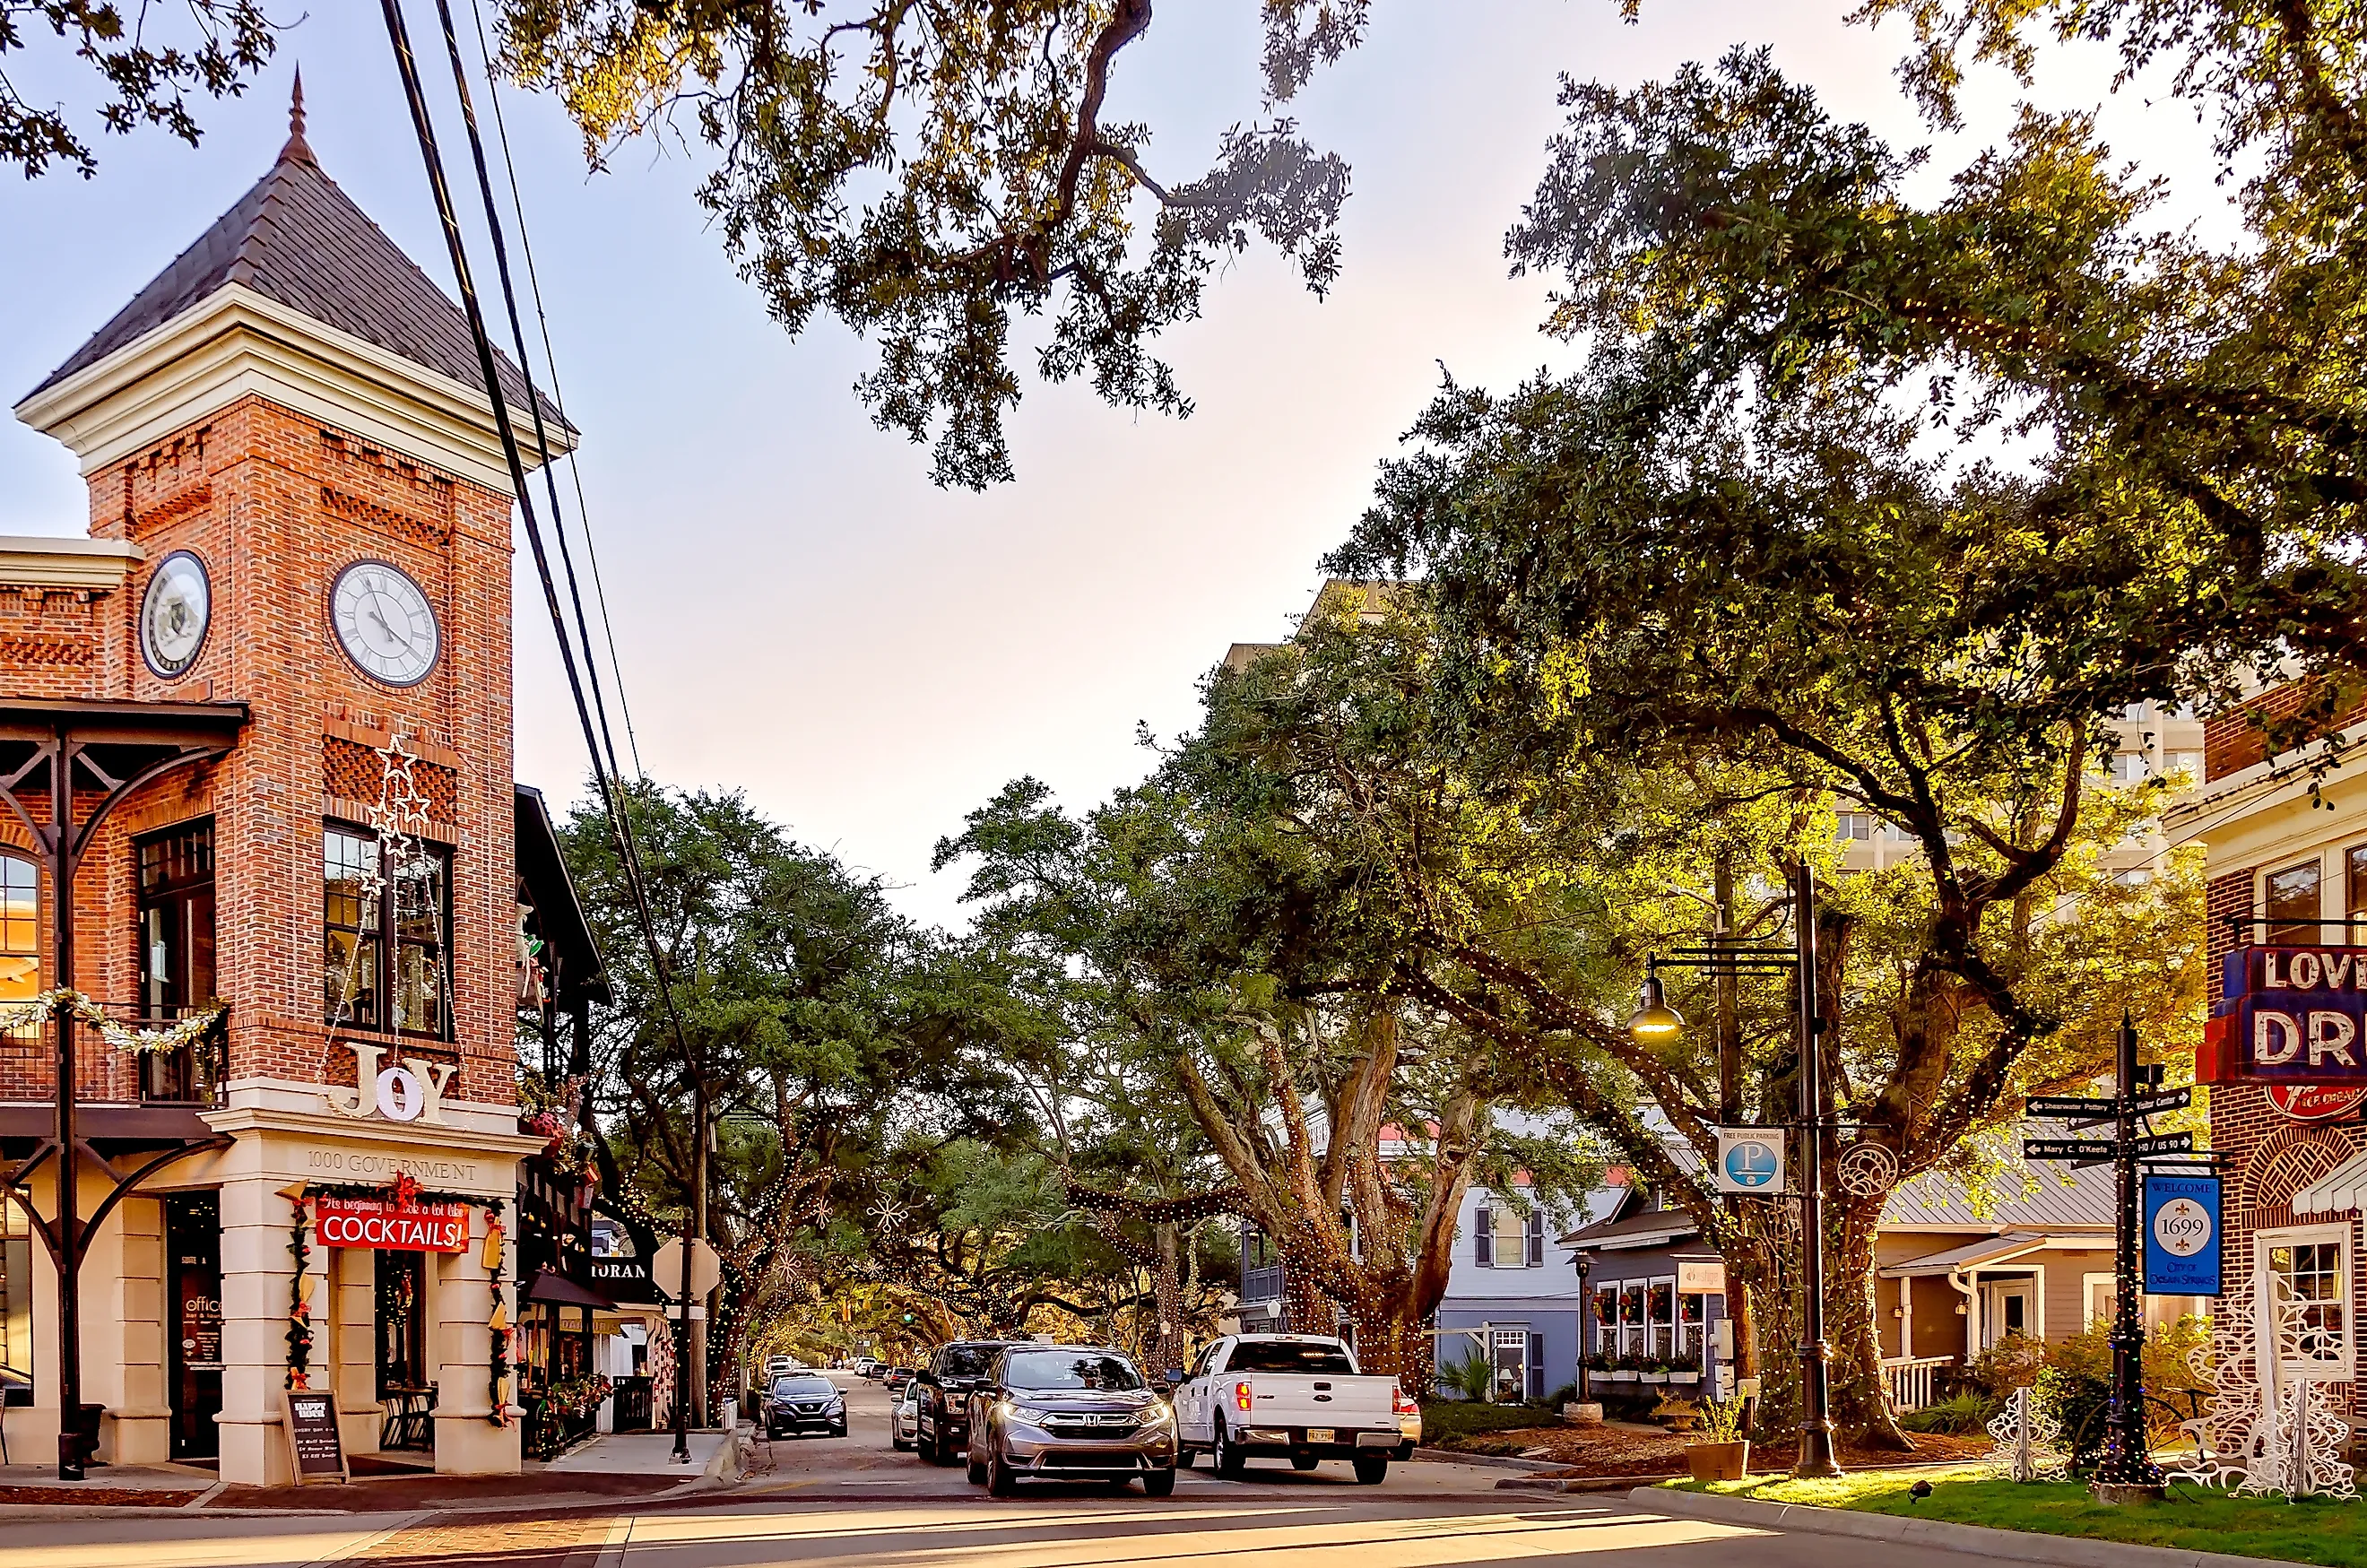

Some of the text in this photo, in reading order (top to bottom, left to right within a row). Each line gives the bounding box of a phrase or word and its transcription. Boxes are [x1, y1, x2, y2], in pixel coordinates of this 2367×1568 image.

[2254, 1011, 2367, 1066] DR
[328, 1042, 458, 1127] JOY
[2084, 1103, 2109, 1113] Pottery
[2136, 1096, 2176, 1111] Visitor Center
[2044, 1145, 2064, 1155] Mary
[2157, 1141, 2167, 1150] US
[2169, 1139, 2179, 1149] 90
[308, 1150, 477, 1181] 1000 GOVERNMENT
[1742, 1144, 1764, 1170] P
[2152, 1183, 2212, 1193] WELCOME
[386, 1200, 395, 1213] to
[422, 1206, 429, 1216] a
[431, 1202, 445, 1217] lot
[447, 1203, 464, 1217] like
[324, 1216, 464, 1247] COCKTAILS!
[2162, 1217, 2204, 1236] 1699
